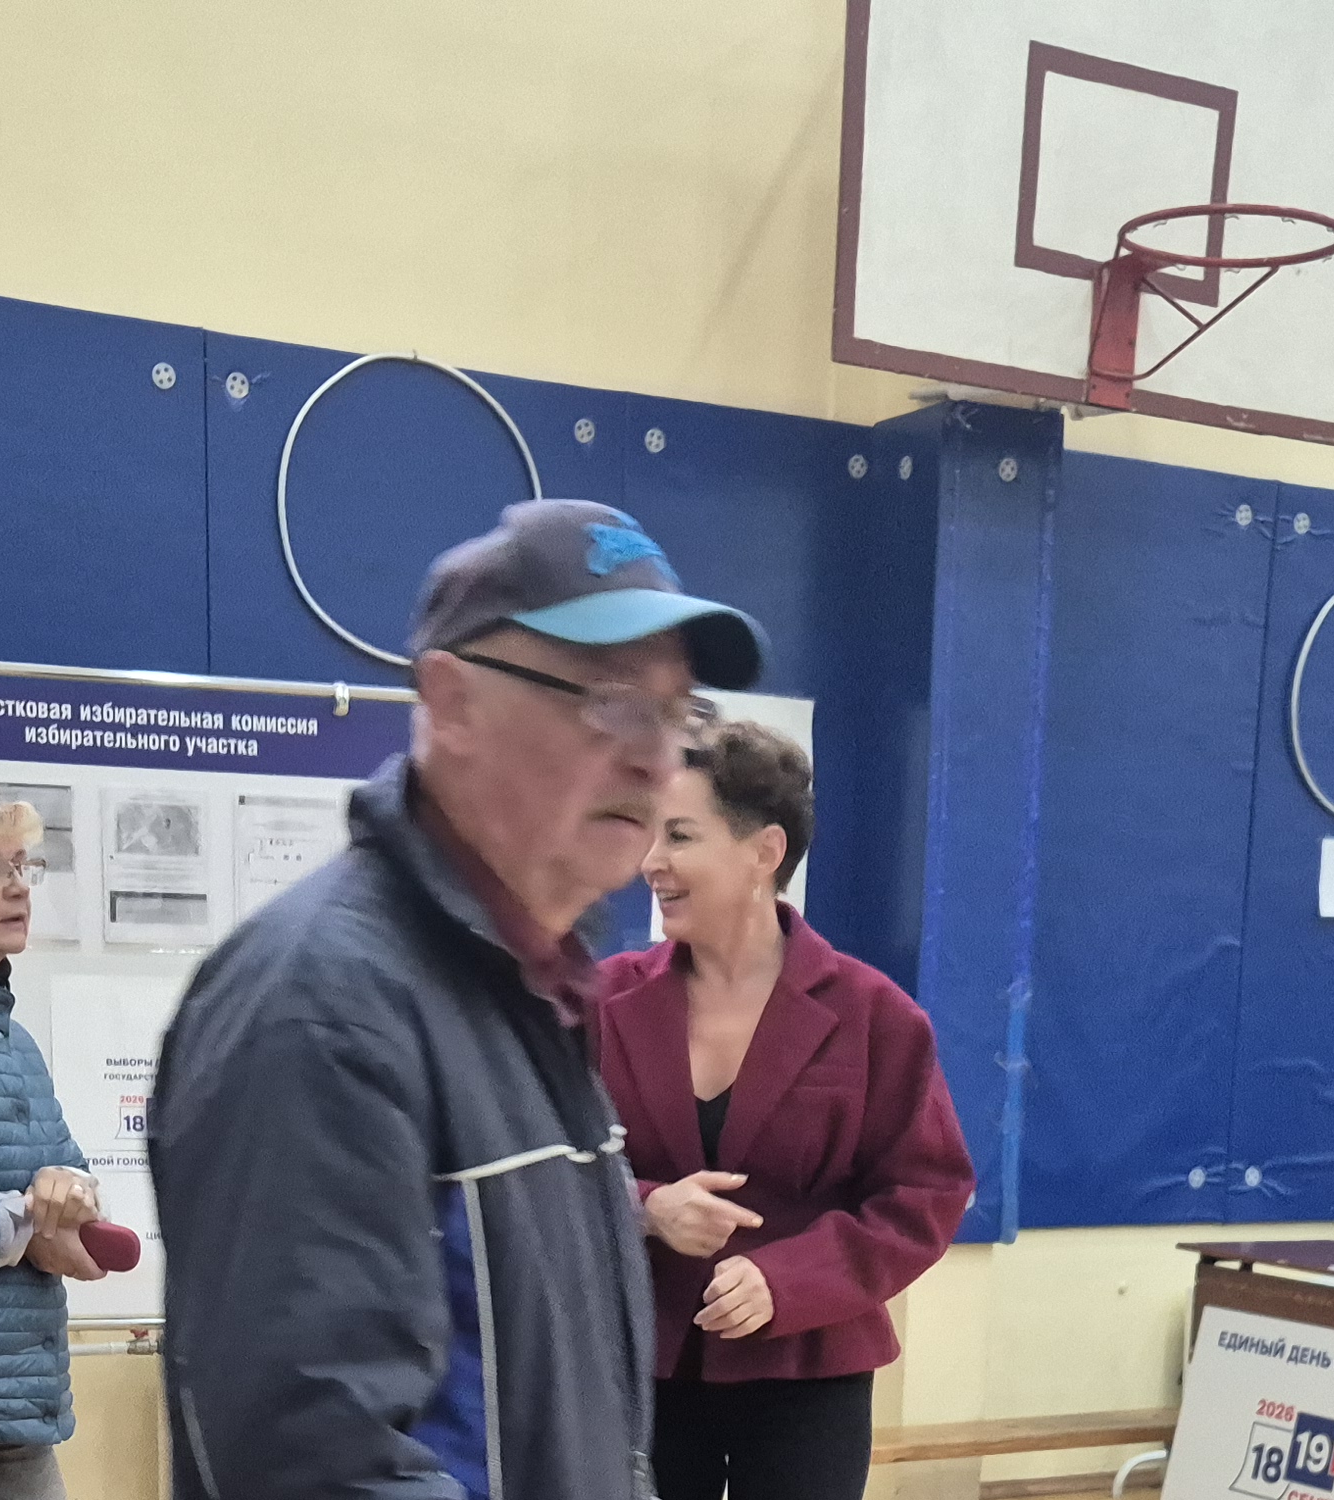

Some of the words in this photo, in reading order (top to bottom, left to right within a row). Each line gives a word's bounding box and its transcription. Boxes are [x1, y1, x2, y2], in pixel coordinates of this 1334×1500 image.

[79, 702, 224, 730] избирательная
[231, 713, 318, 736] комиссия
[24, 724, 180, 752] избирательного
[184, 735, 258, 757] участка
[106, 1058, 152, 1067] ВЫБОРЫ
[123, 1115, 145, 1132] 18
[1218, 1330, 1285, 1359] ЕДИНЫЙ
[1286, 1345, 1331, 1369] ДЕНЬ
[1256, 1399, 1294, 1422] 2026
[1251, 1443, 1283, 1483] 18
[1295, 1430, 1330, 1473] 19
